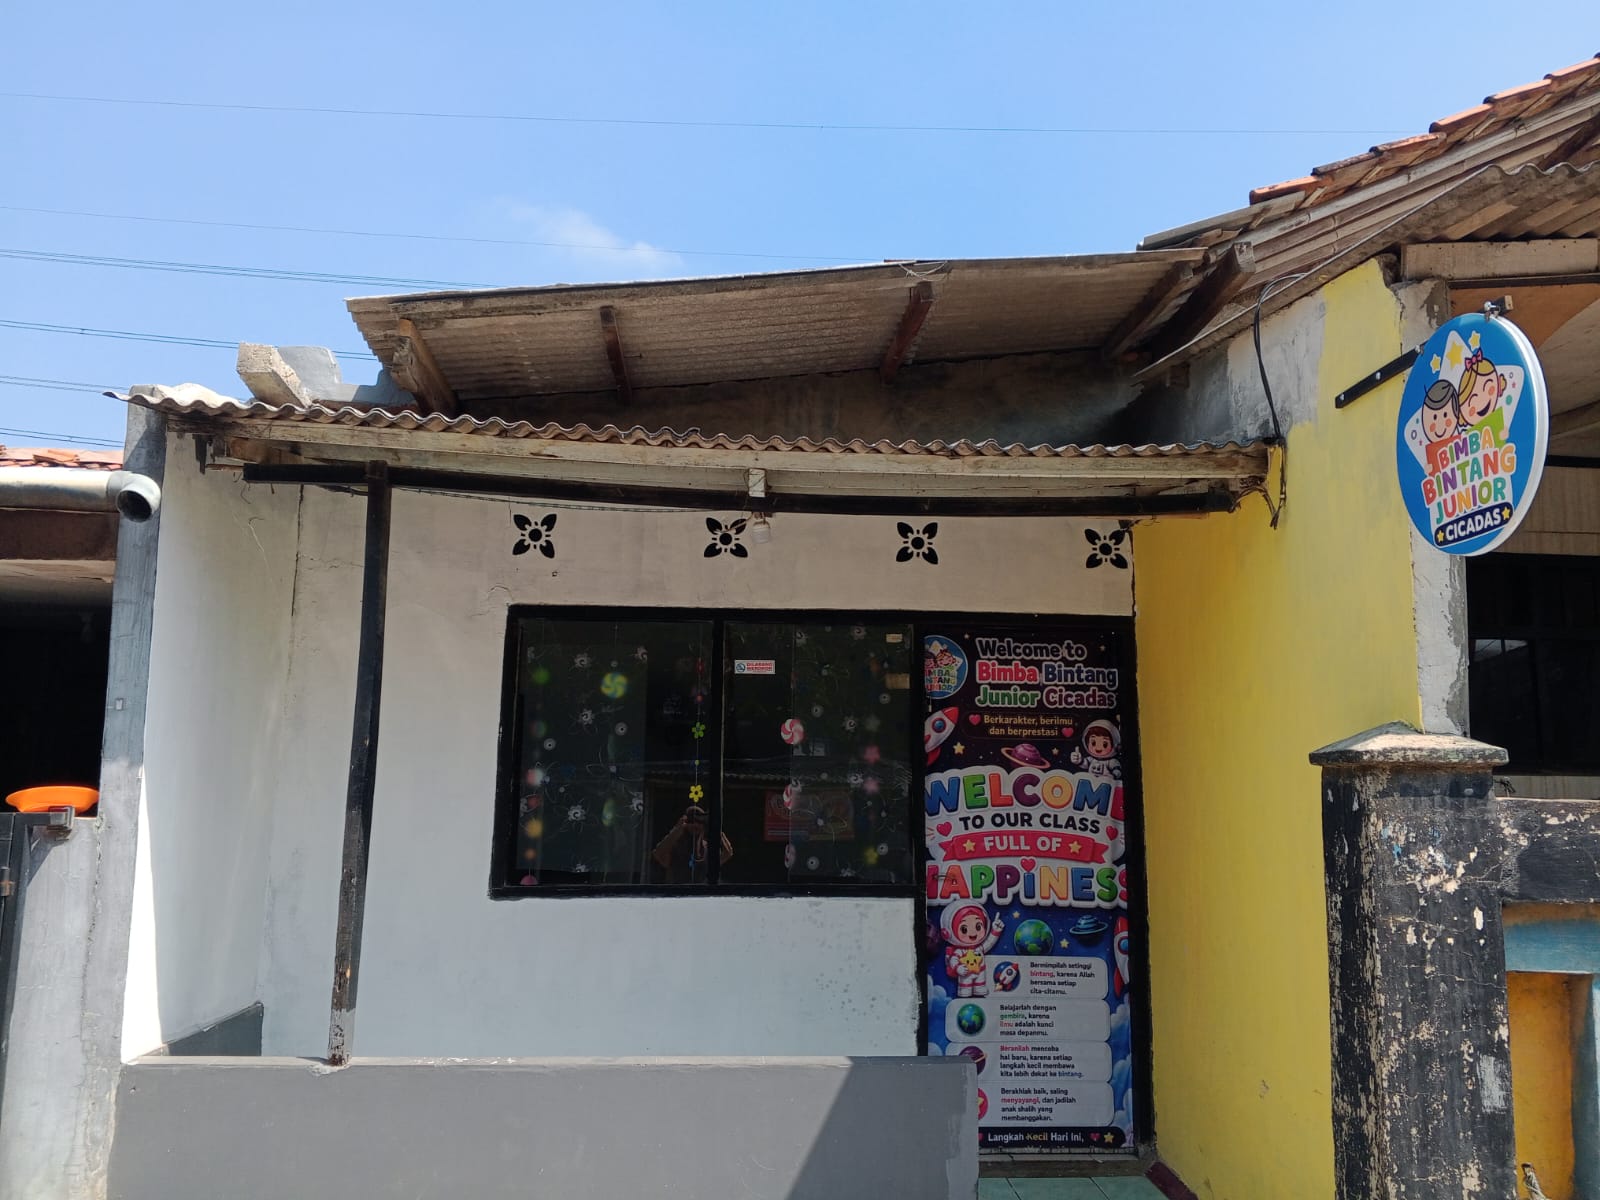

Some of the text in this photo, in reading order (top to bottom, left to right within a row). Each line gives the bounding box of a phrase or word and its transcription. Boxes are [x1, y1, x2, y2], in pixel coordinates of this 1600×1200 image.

[1438, 426, 1494, 470] BIMBA
[1422, 444, 1516, 506] BINTANG
[1435, 477, 1507, 525] JUNIOR
[1445, 507, 1502, 542] CICADAS
[976, 637, 1087, 660] Welcome to
[977, 660, 1118, 689] Bimba Bintang
[976, 685, 1116, 708] Junior Cicadas
[984, 714, 1073, 726] Berkarakter, berilmu
[989, 727, 1058, 738] dan berprestasi
[959, 813, 1100, 834] TO OUR CLASS
[984, 836, 1062, 852] FULL OF
[1030, 961, 1092, 970] Bermimpilah setinggi
[1030, 970, 1055, 979] bintang,
[1057, 980, 1077, 988] setiap
[1030, 987, 1067, 995] cita-citamu.
[1000, 1004, 1057, 1012] Belajarlah dengan
[1000, 1012, 1027, 1020] gembira,
[1017, 1029, 1048, 1037] depanmu.
[1000, 1062, 1026, 1070] langkah
[1058, 1071, 1084, 1079] bintang.
[1033, 1088, 1049, 1096] baik,
[1050, 1088, 1068, 1096] saling
[1001, 1097, 1041, 1105] menyayangi,
[1055, 1097, 1076, 1105] jadilah
[988, 1133, 1084, 1144] Langkah Kecil Hari Ini,
